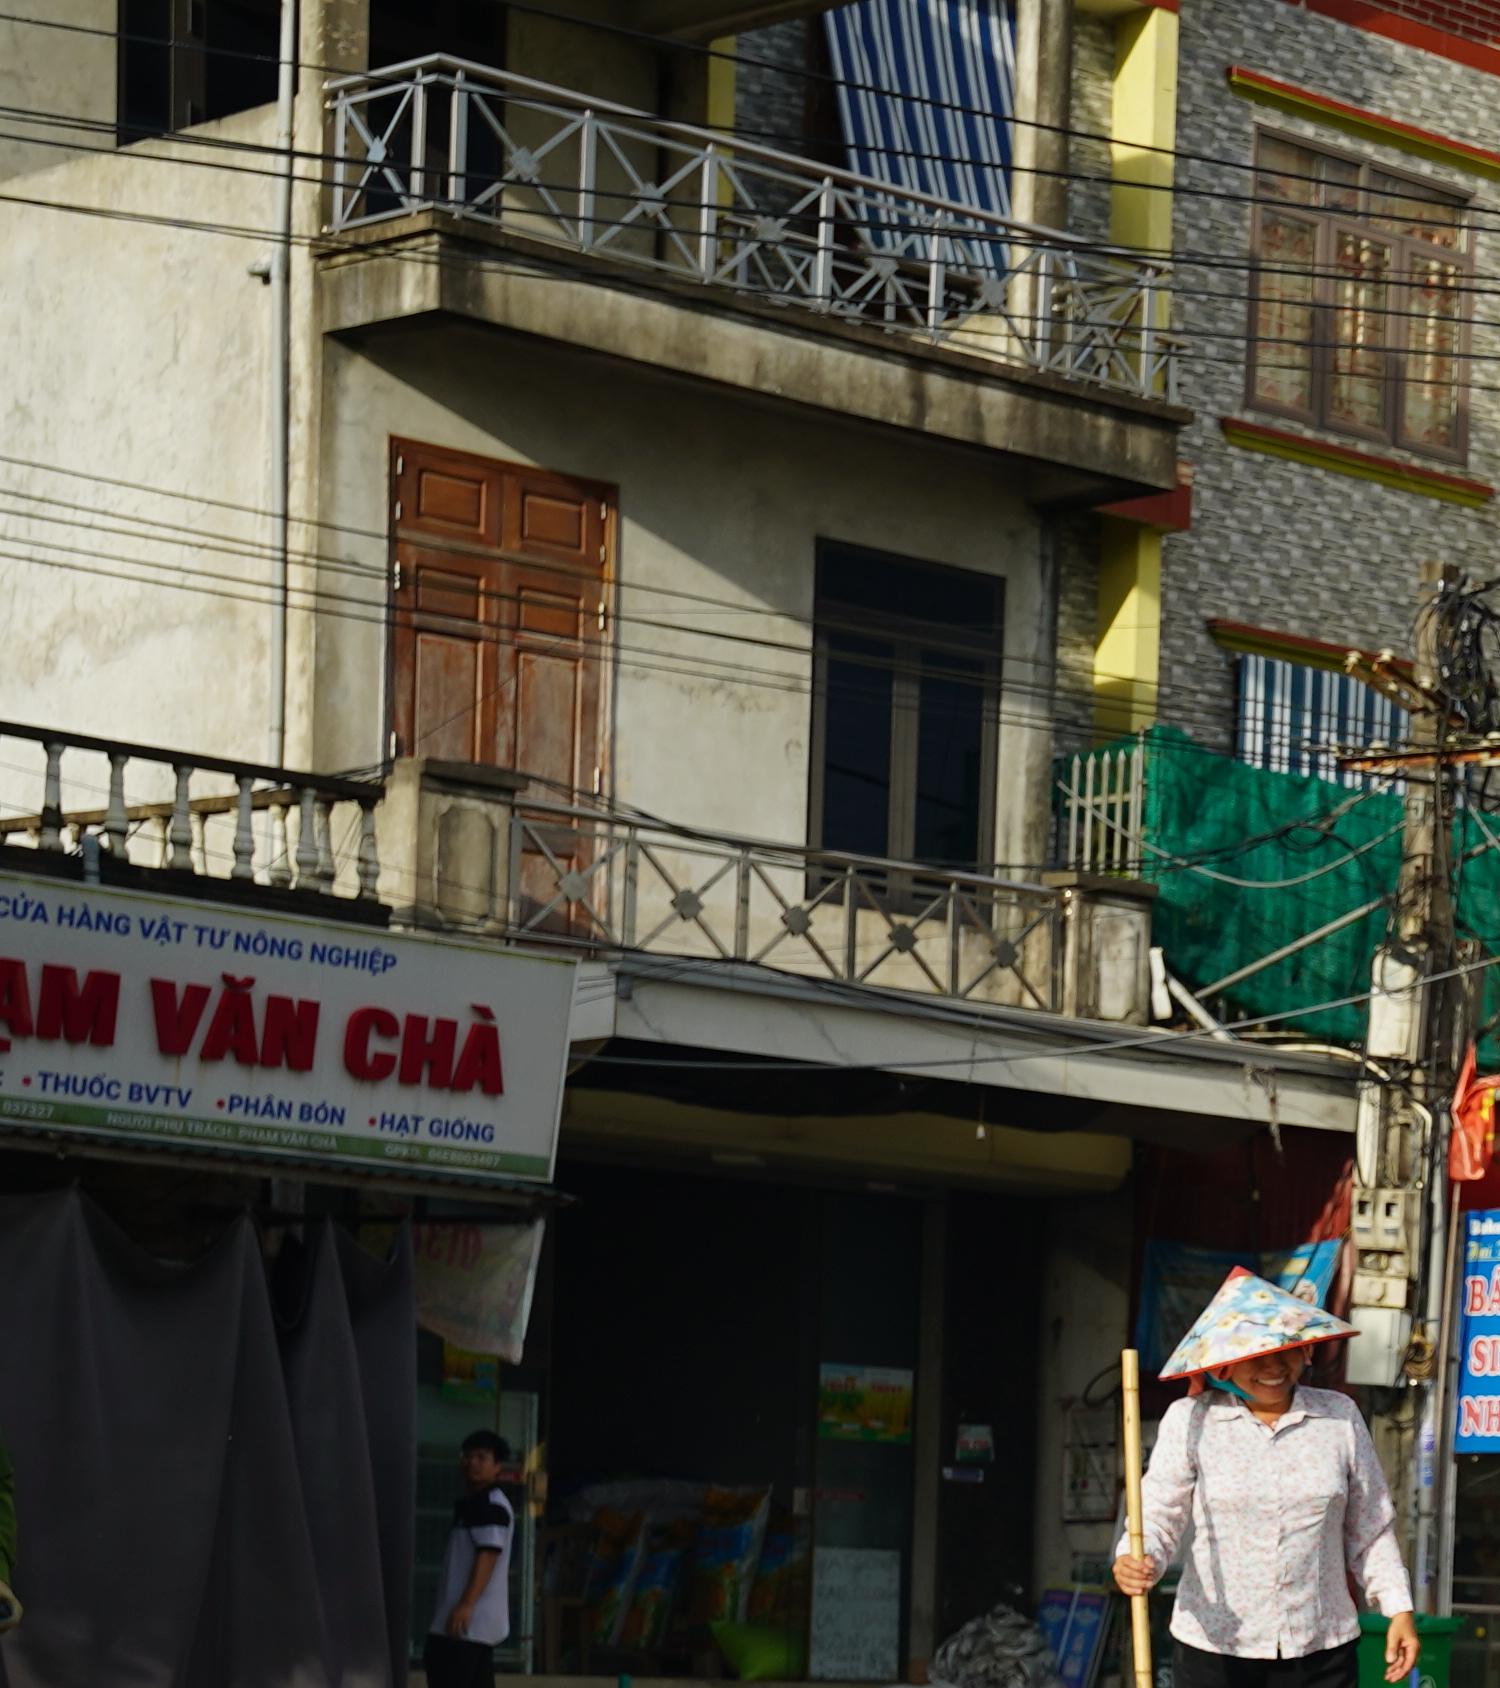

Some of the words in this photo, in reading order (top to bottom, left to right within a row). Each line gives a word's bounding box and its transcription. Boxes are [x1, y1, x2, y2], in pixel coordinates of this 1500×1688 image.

[57, 904, 131, 936] HÀNG
[139, 915, 188, 946] VẬT
[194, 924, 230, 949] TƯ
[233, 930, 302, 960] NÔNG
[310, 944, 397, 976] NGHIỆP
[151, 971, 320, 1073] VĂN
[343, 1003, 504, 1096] CHÀ
[38, 1071, 122, 1099] THUỐC
[128, 1082, 192, 1108] BVTV
[228, 1092, 292, 1120] PHÂN
[300, 1099, 346, 1126] BÓN
[380, 1112, 424, 1138] HẠT
[429, 1113, 495, 1143] GIỐNG
